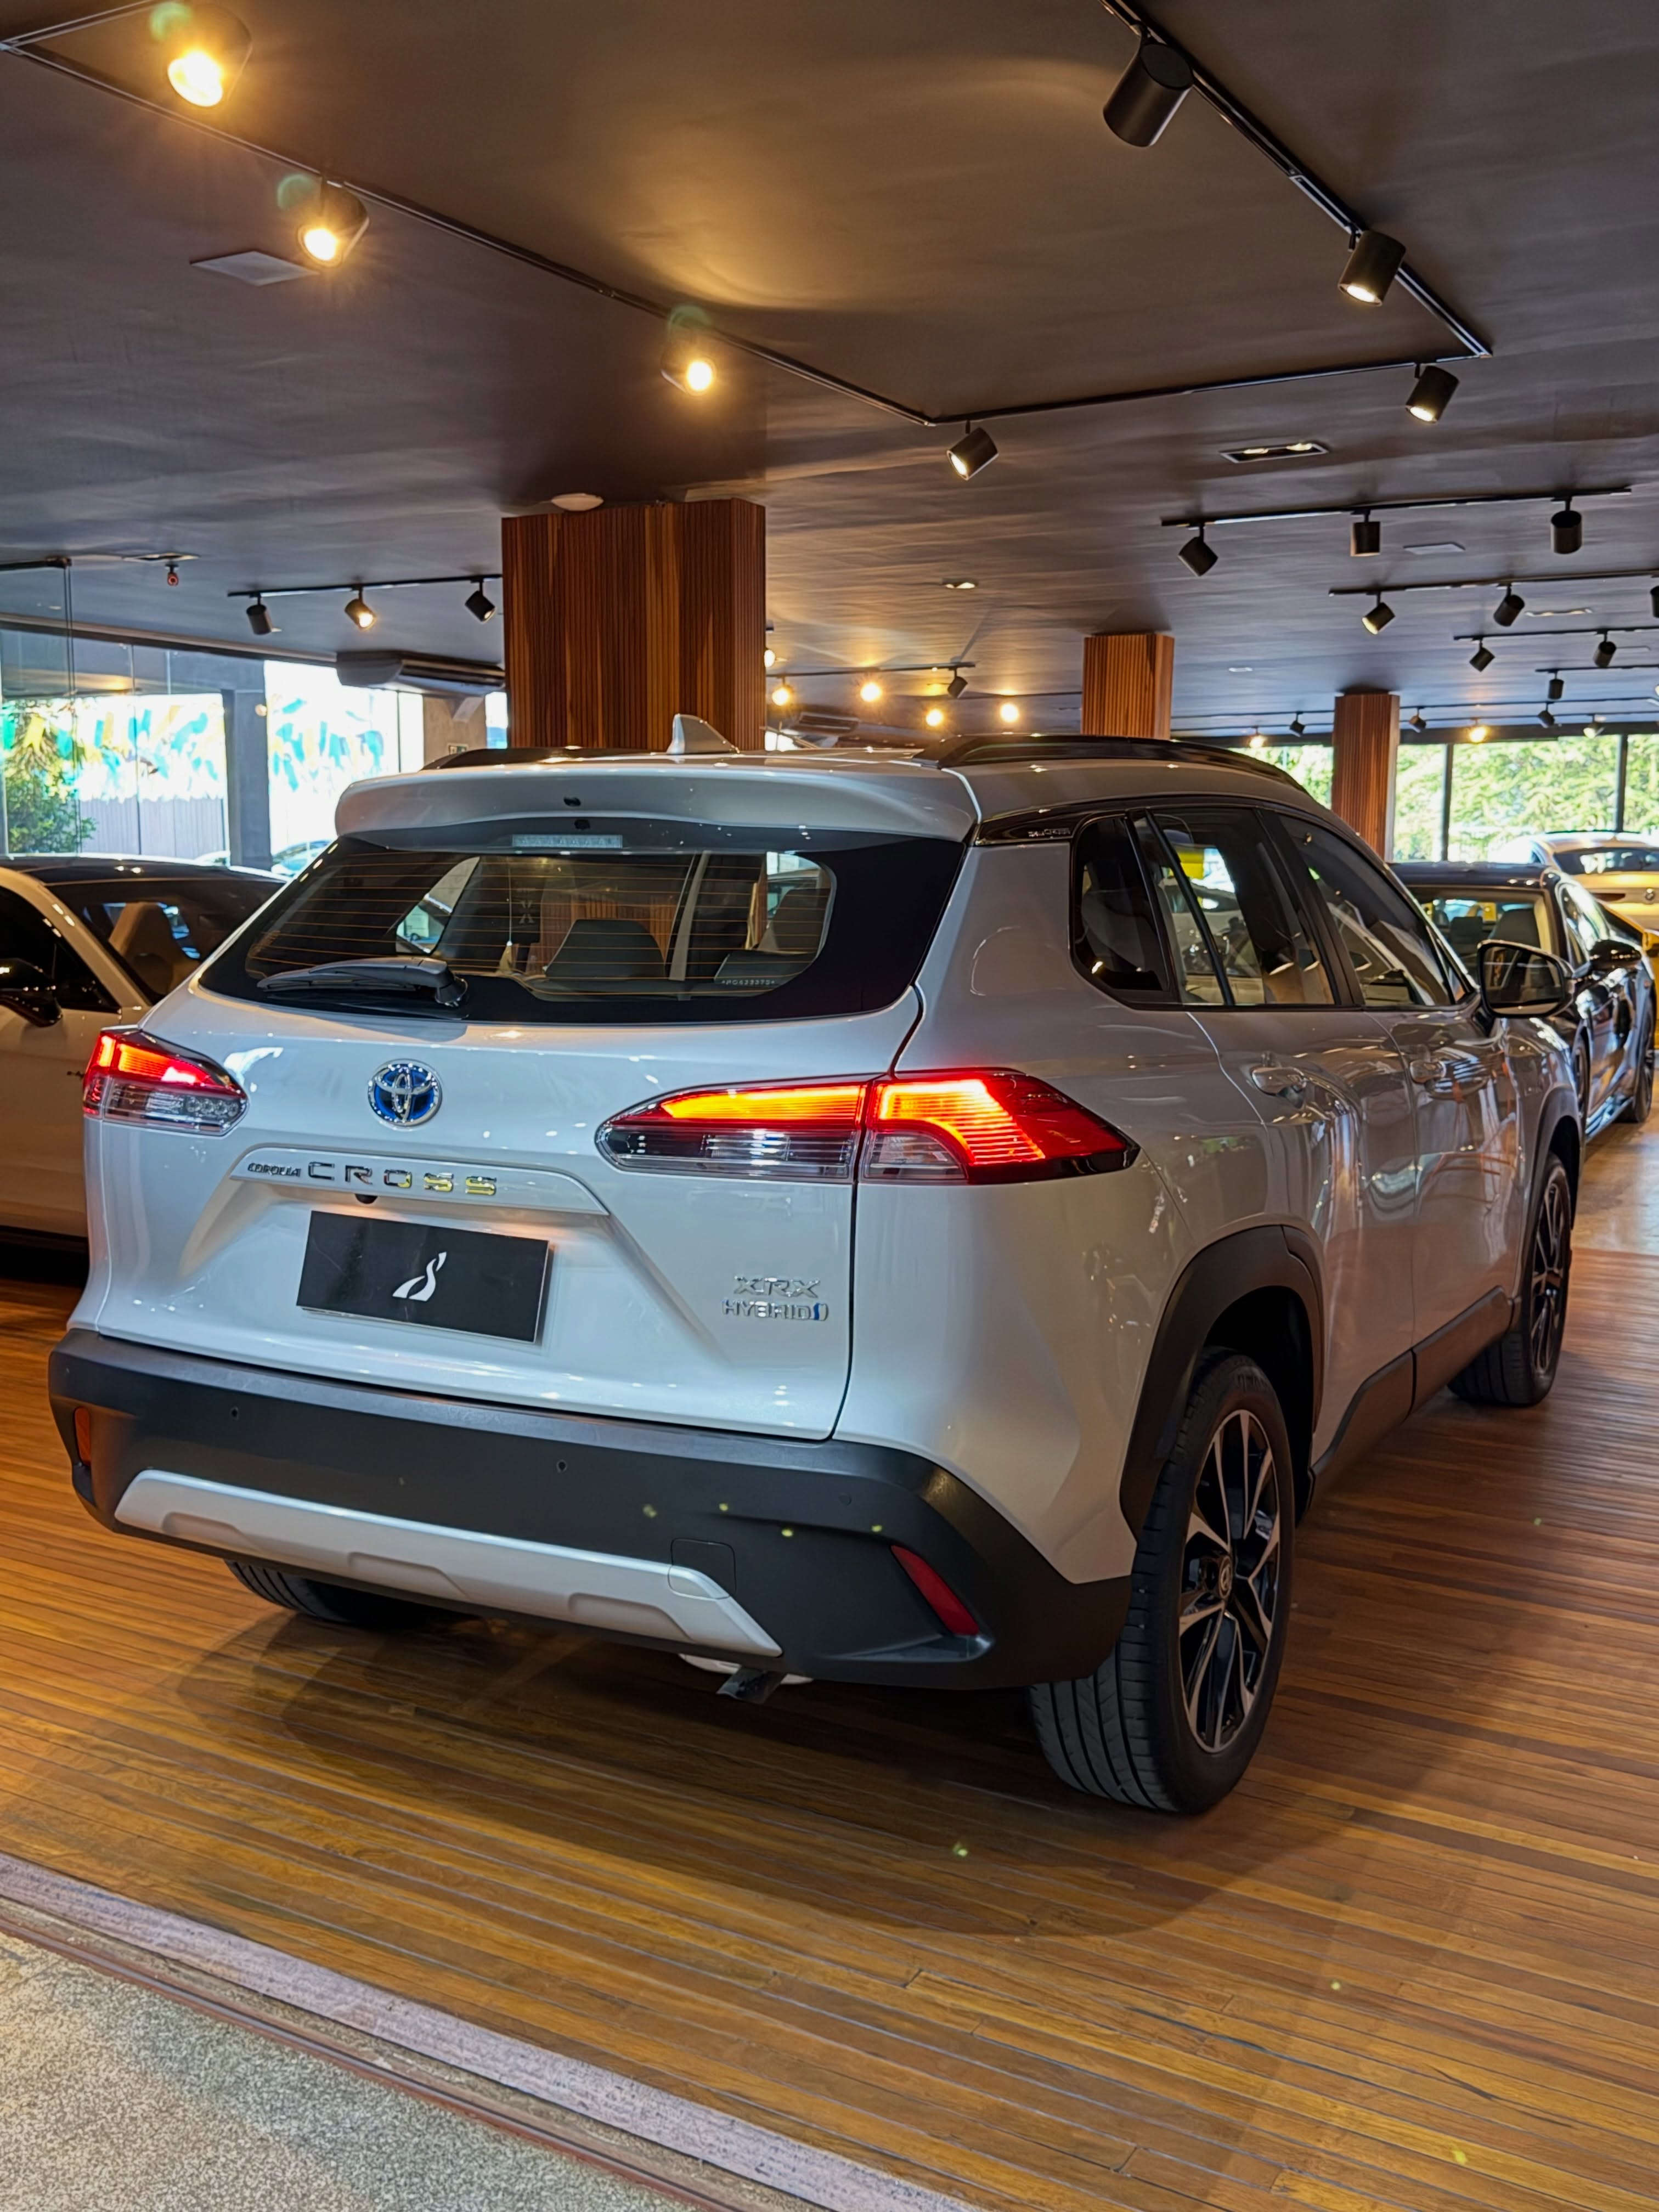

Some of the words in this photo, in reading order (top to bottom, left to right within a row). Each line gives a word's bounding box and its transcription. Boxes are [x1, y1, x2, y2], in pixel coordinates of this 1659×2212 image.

[247, 1163, 301, 1177] COROLLA
[308, 1161, 496, 1196] CROSS
[733, 1276, 821, 1299] XRX
[721, 1300, 811, 1320] HYBRID
